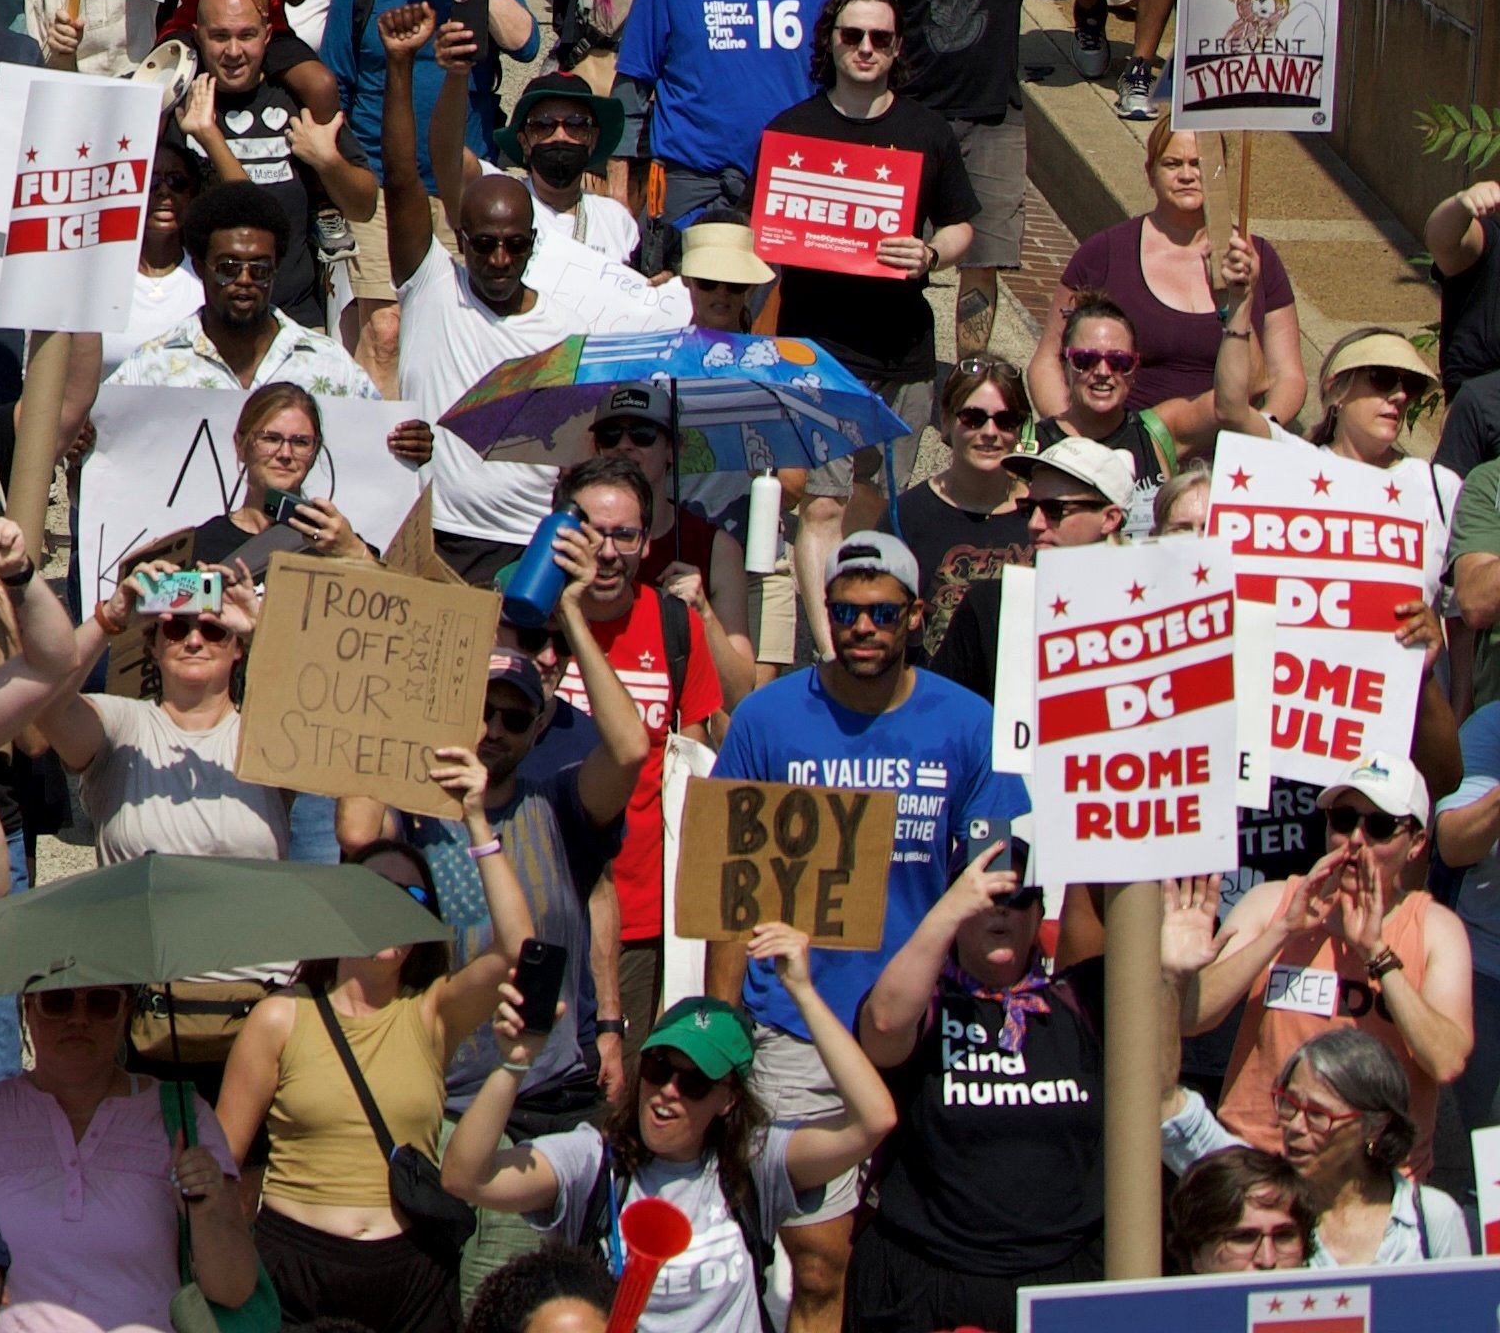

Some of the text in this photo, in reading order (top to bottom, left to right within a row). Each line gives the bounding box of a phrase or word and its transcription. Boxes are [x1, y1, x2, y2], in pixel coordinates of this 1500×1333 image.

[703, 1, 748, 16] Hillary
[703, 13, 753, 27] Clinton
[756, 0, 804, 49] 16
[705, 25, 731, 37] Tim
[708, 36, 746, 51] Kaine
[728, 788, 867, 870] BOY
[721, 860, 850, 935] BYE
